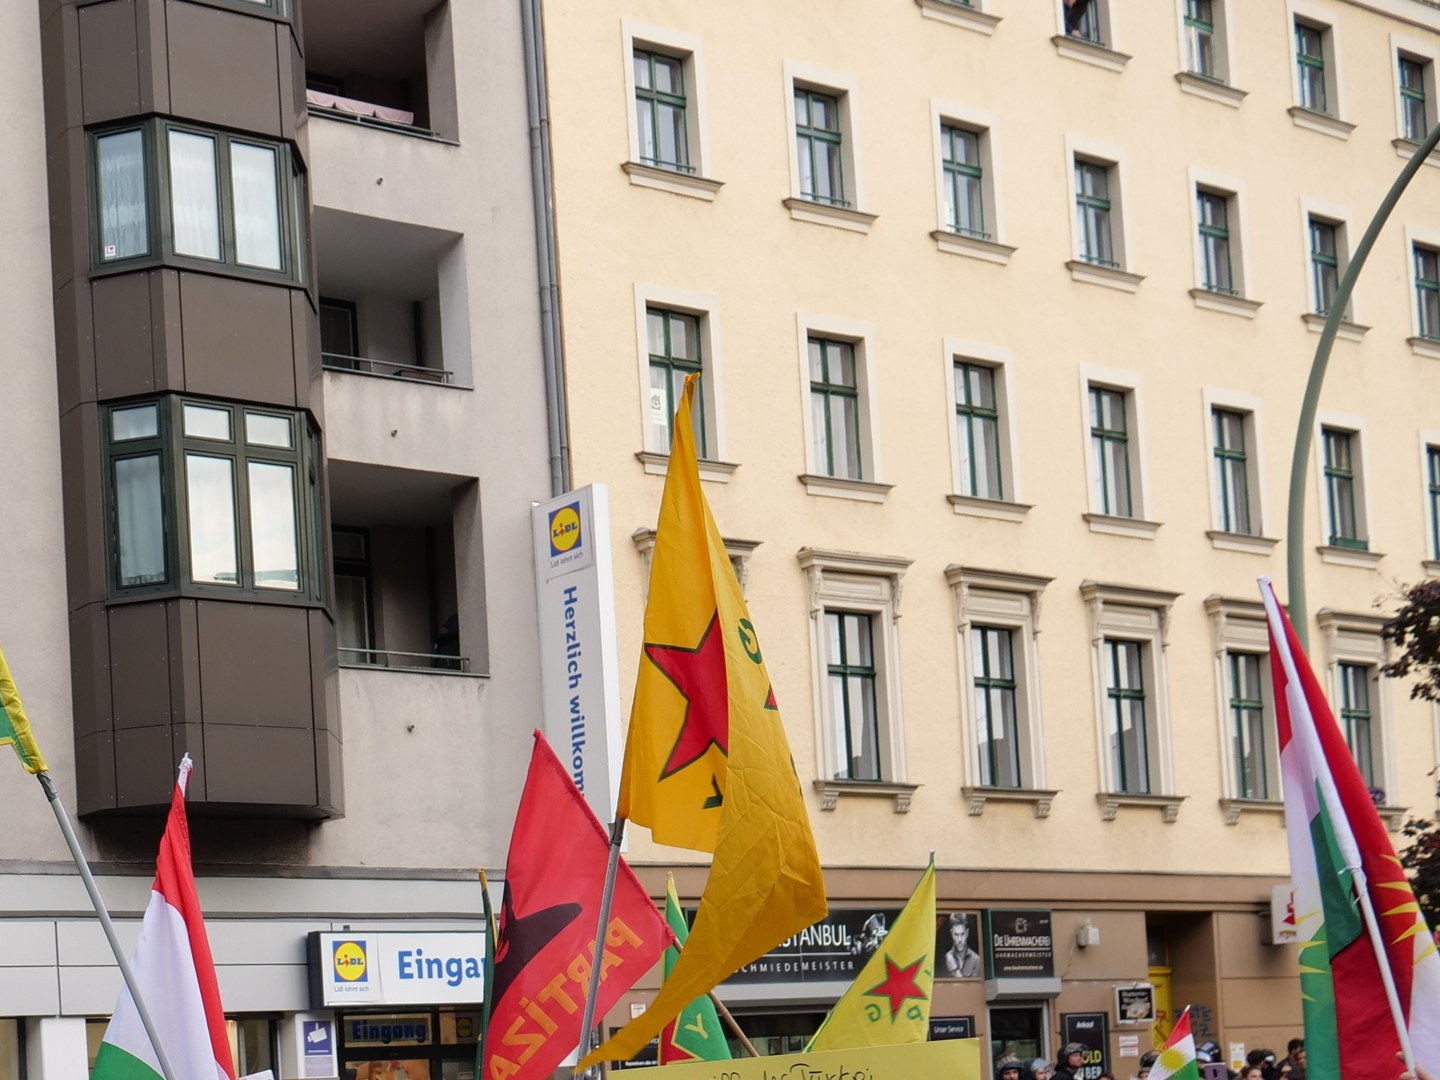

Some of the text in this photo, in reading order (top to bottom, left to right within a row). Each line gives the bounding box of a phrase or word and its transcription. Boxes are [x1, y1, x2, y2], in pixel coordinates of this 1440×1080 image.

[563, 586, 586, 797] Herzlich willkom
[398, 948, 486, 987] Einga
[734, 961, 854, 973] CHMIEDEMEISTER
[352, 1020, 427, 1044] Eingang
[1082, 1050, 1102, 1064] OLD
